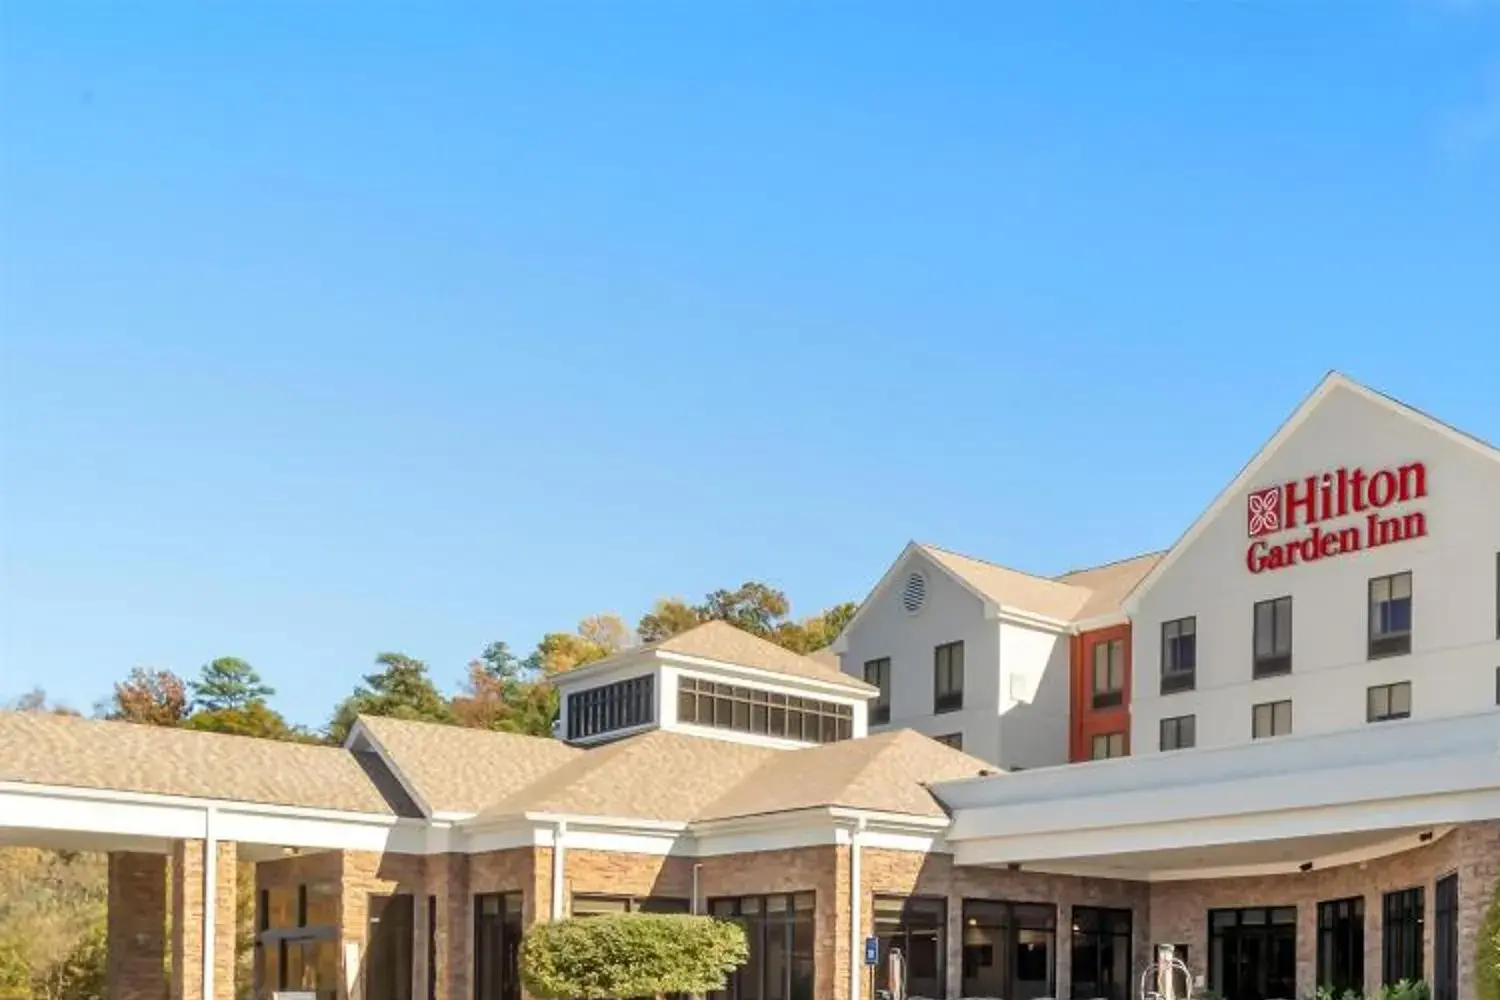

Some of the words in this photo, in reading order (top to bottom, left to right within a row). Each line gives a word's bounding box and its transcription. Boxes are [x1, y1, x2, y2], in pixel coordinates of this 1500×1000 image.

[1284, 460, 1428, 528] Hilton
[1246, 524, 1361, 574] Garden
[1366, 511, 1428, 549] Inn
